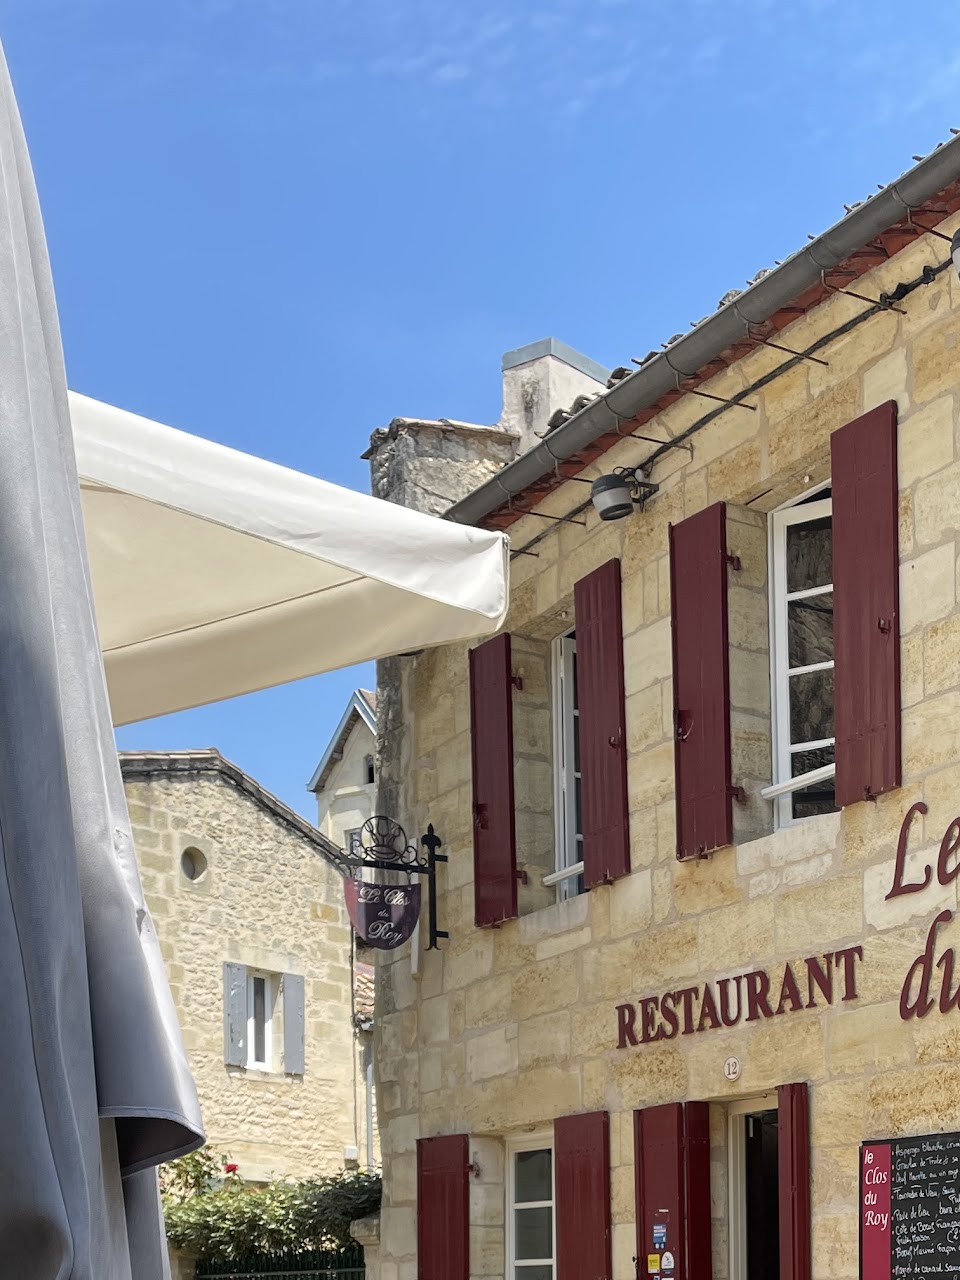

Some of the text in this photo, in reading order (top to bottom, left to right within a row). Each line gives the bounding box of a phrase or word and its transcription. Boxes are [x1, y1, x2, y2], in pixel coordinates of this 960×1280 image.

[358, 887, 410, 905] Le Clos
[378, 909, 389, 917] du
[368, 920, 403, 945] Roy
[616, 946, 863, 1048] RESTAURANT
[727, 1061, 738, 1076] 12
[865, 1167, 888, 1185] Clos
[864, 1191, 878, 1205] du
[865, 1211, 888, 1231] Roy
[910, 1223, 917, 1233] de
